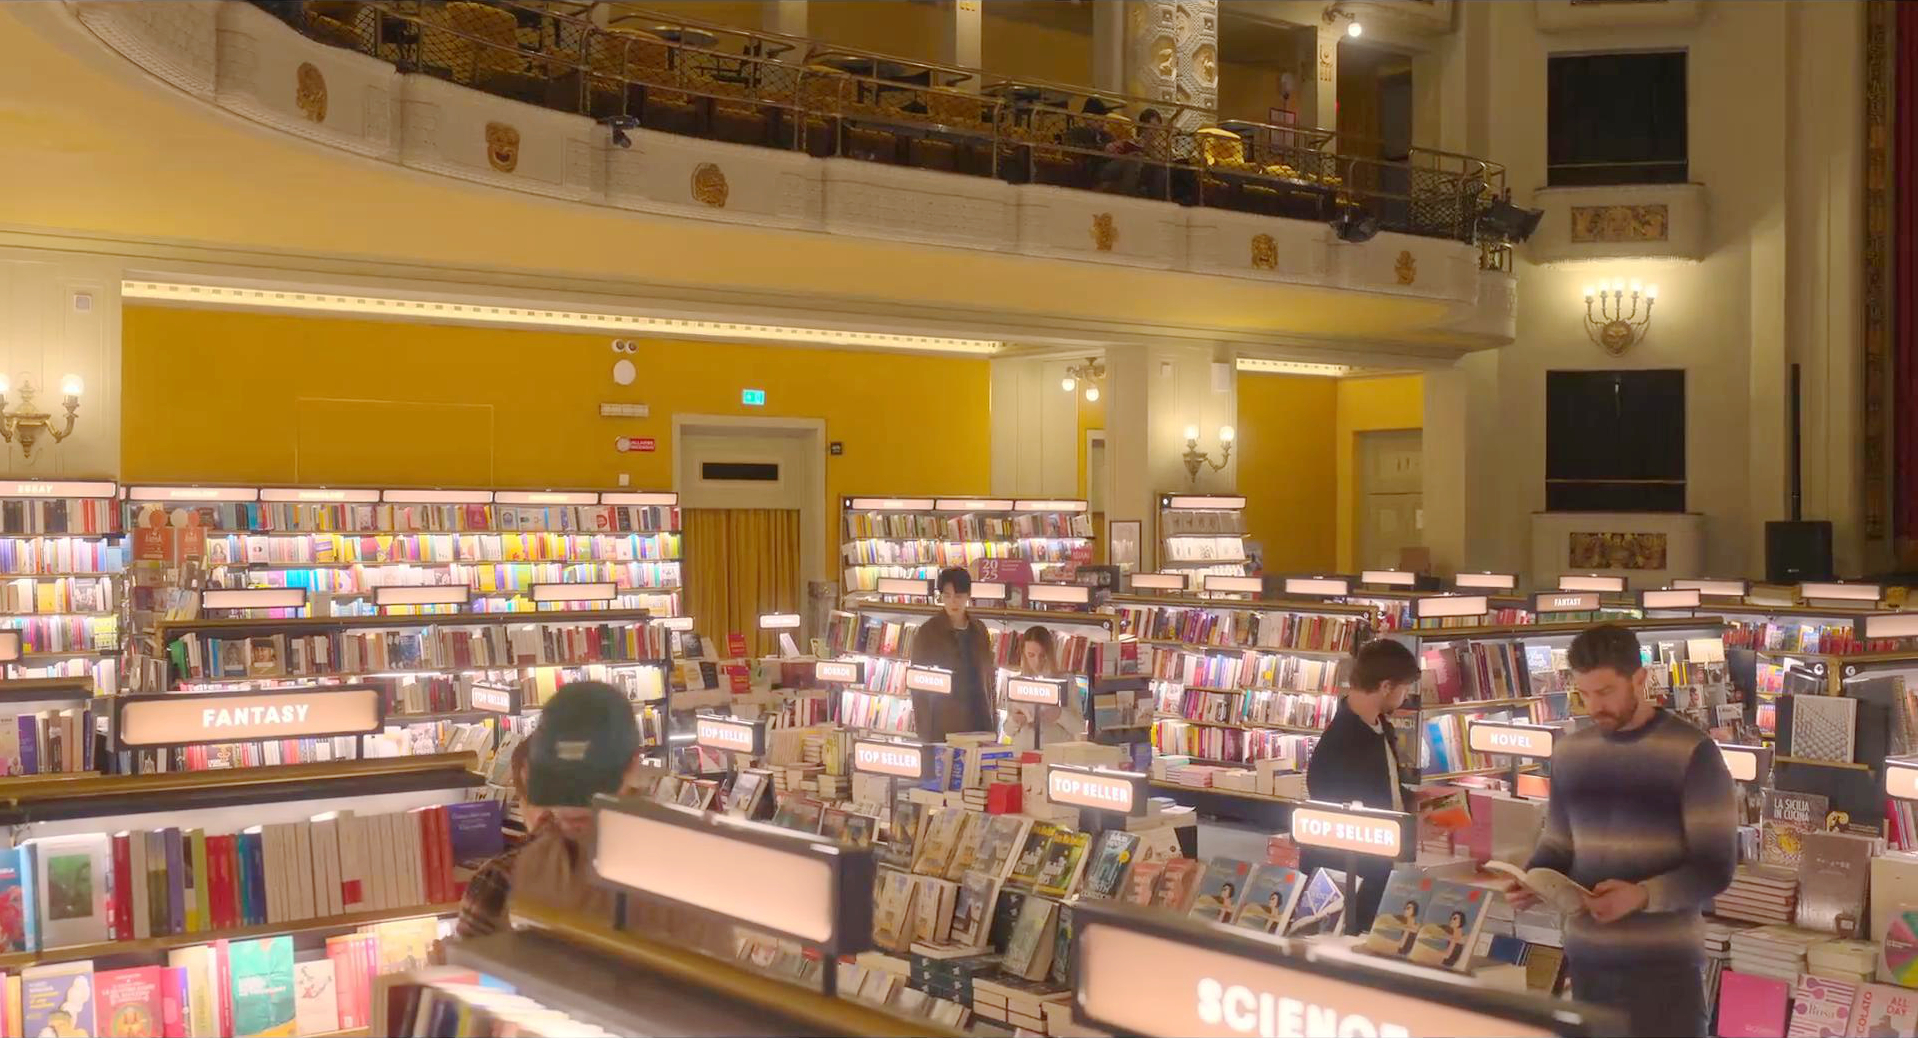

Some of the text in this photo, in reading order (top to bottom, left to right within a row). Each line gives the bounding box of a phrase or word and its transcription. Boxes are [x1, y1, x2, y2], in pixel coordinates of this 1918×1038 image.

[982, 560, 998, 570] 20
[982, 570, 998, 580] 25
[1554, 597, 1581, 607] FANTASY
[1017, 685, 1051, 698] HORROR
[203, 704, 309, 728] FANTASY
[1490, 733, 1532, 748] NOVEL
[859, 750, 918, 767] TOP SELLER
[1054, 777, 1128, 803] TOP SELLER
[1774, 798, 1810, 812] LA SICILIA
[1774, 809, 1782, 819] IN
[1300, 818, 1395, 845] TOP SELLER
